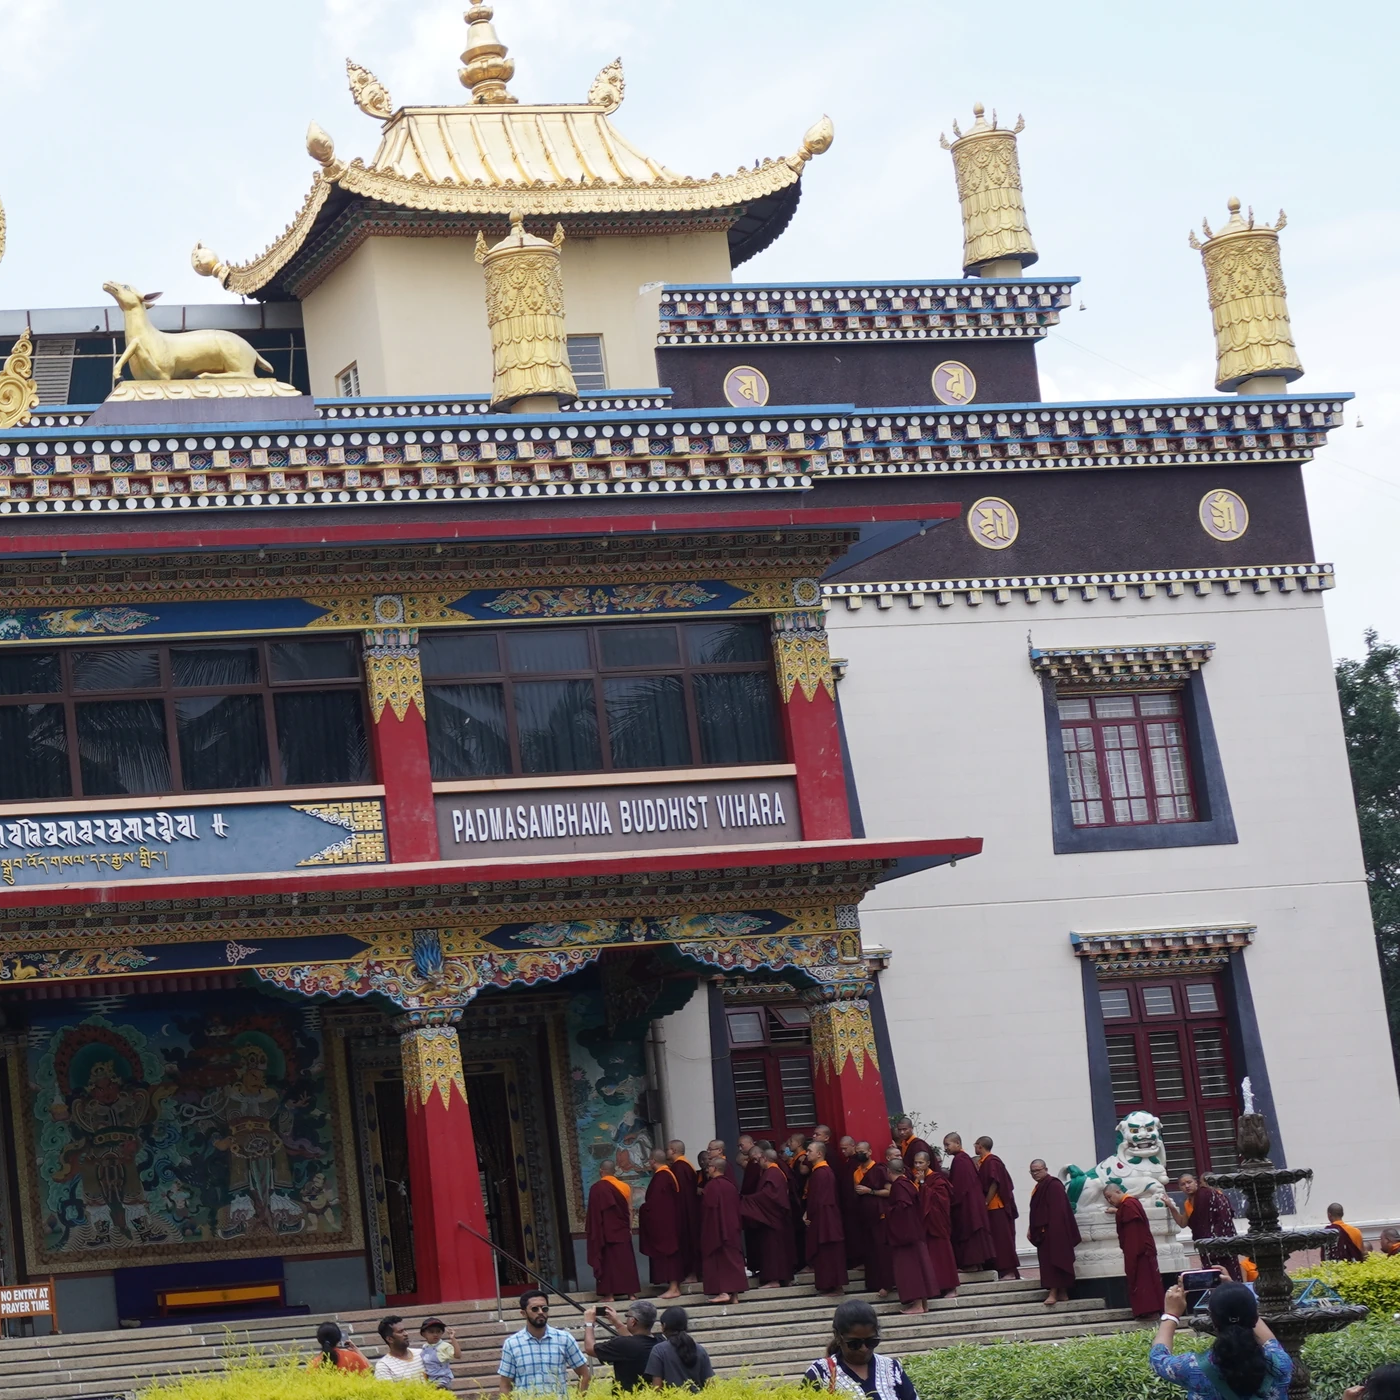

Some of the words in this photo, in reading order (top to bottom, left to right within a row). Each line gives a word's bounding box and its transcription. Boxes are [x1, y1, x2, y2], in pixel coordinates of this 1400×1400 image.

[452, 801, 612, 843] PADMASAMBHAVA
[619, 796, 708, 834] BUDDHIST
[715, 791, 786, 828] VIHARA
[0, 1290, 12, 1301] NO
[13, 1288, 38, 1300] ENTRY
[39, 1287, 48, 1298] AT
[1, 1301, 30, 1314] PRAYER
[30, 1300, 50, 1311] TIME
